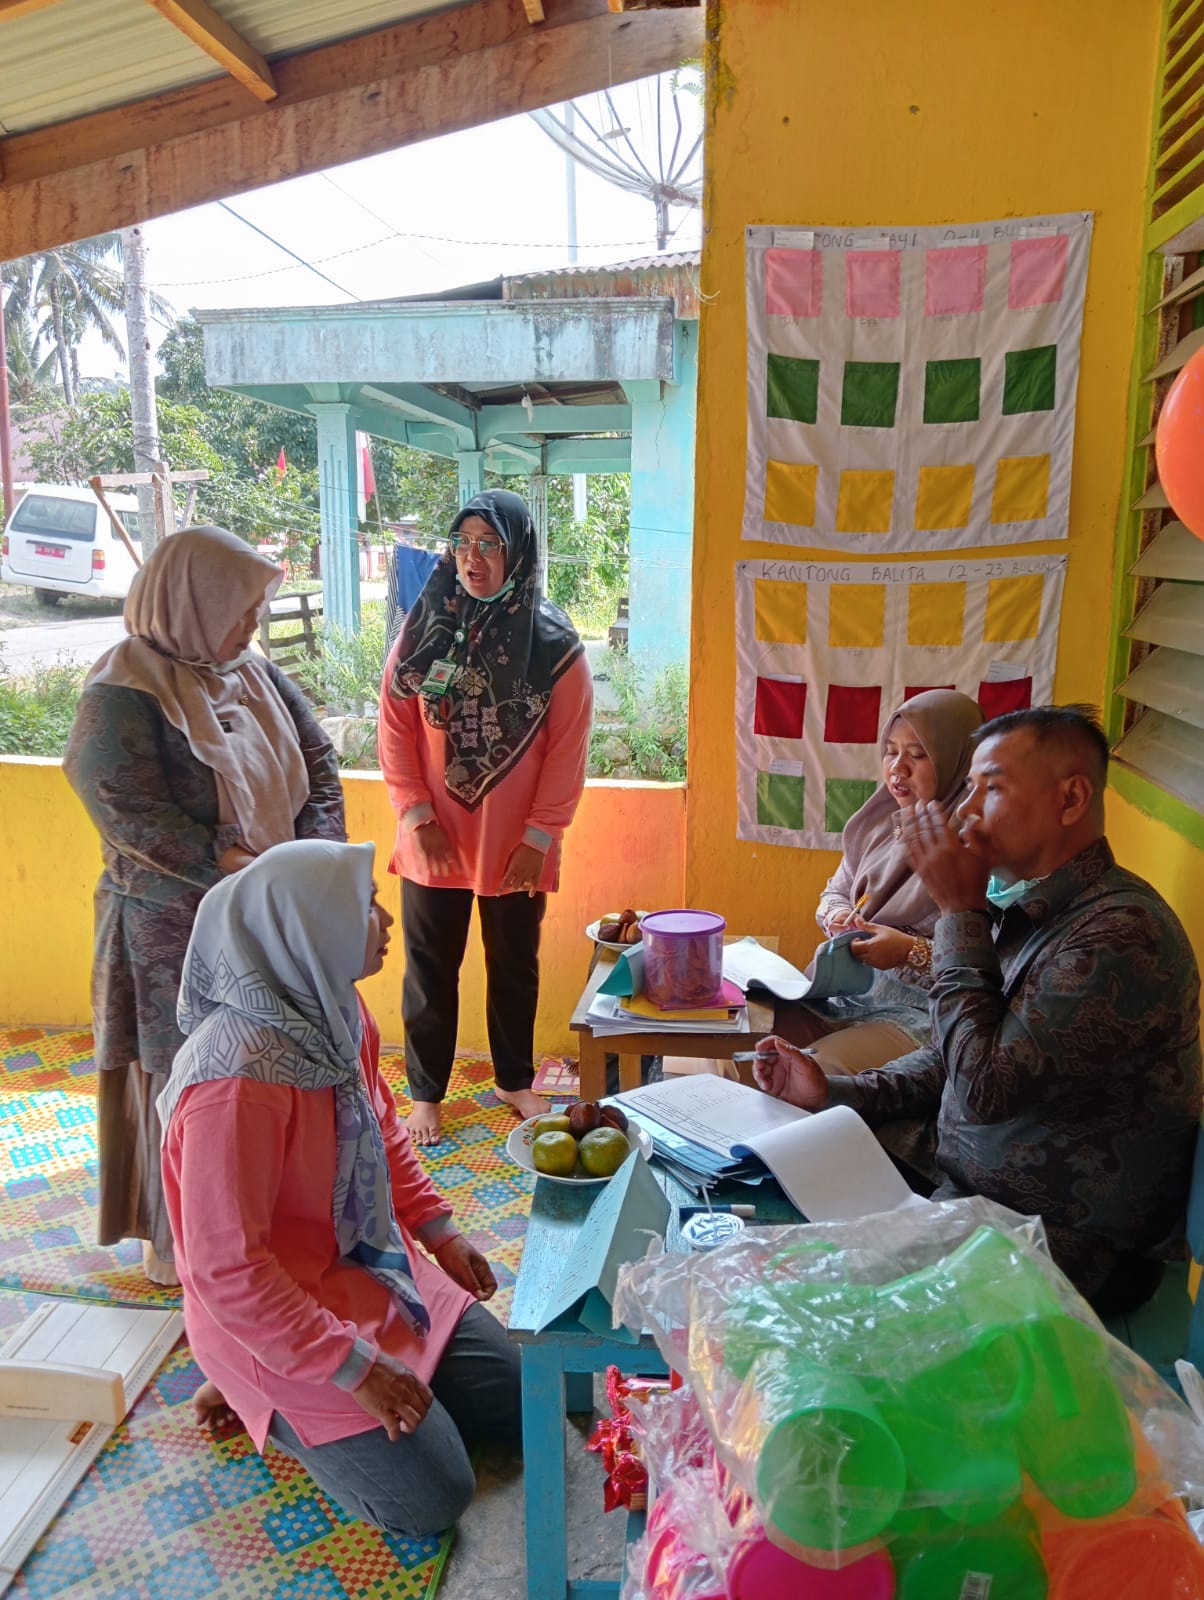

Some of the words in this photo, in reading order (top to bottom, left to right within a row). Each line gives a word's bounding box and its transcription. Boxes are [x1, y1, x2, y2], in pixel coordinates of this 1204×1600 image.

[762, 561, 851, 582] KANTONG
[872, 566, 928, 582] BALITA
[948, 564, 967, 579] 12
[984, 562, 1004, 576] 23
[1012, 559, 1053, 575] BULAN
